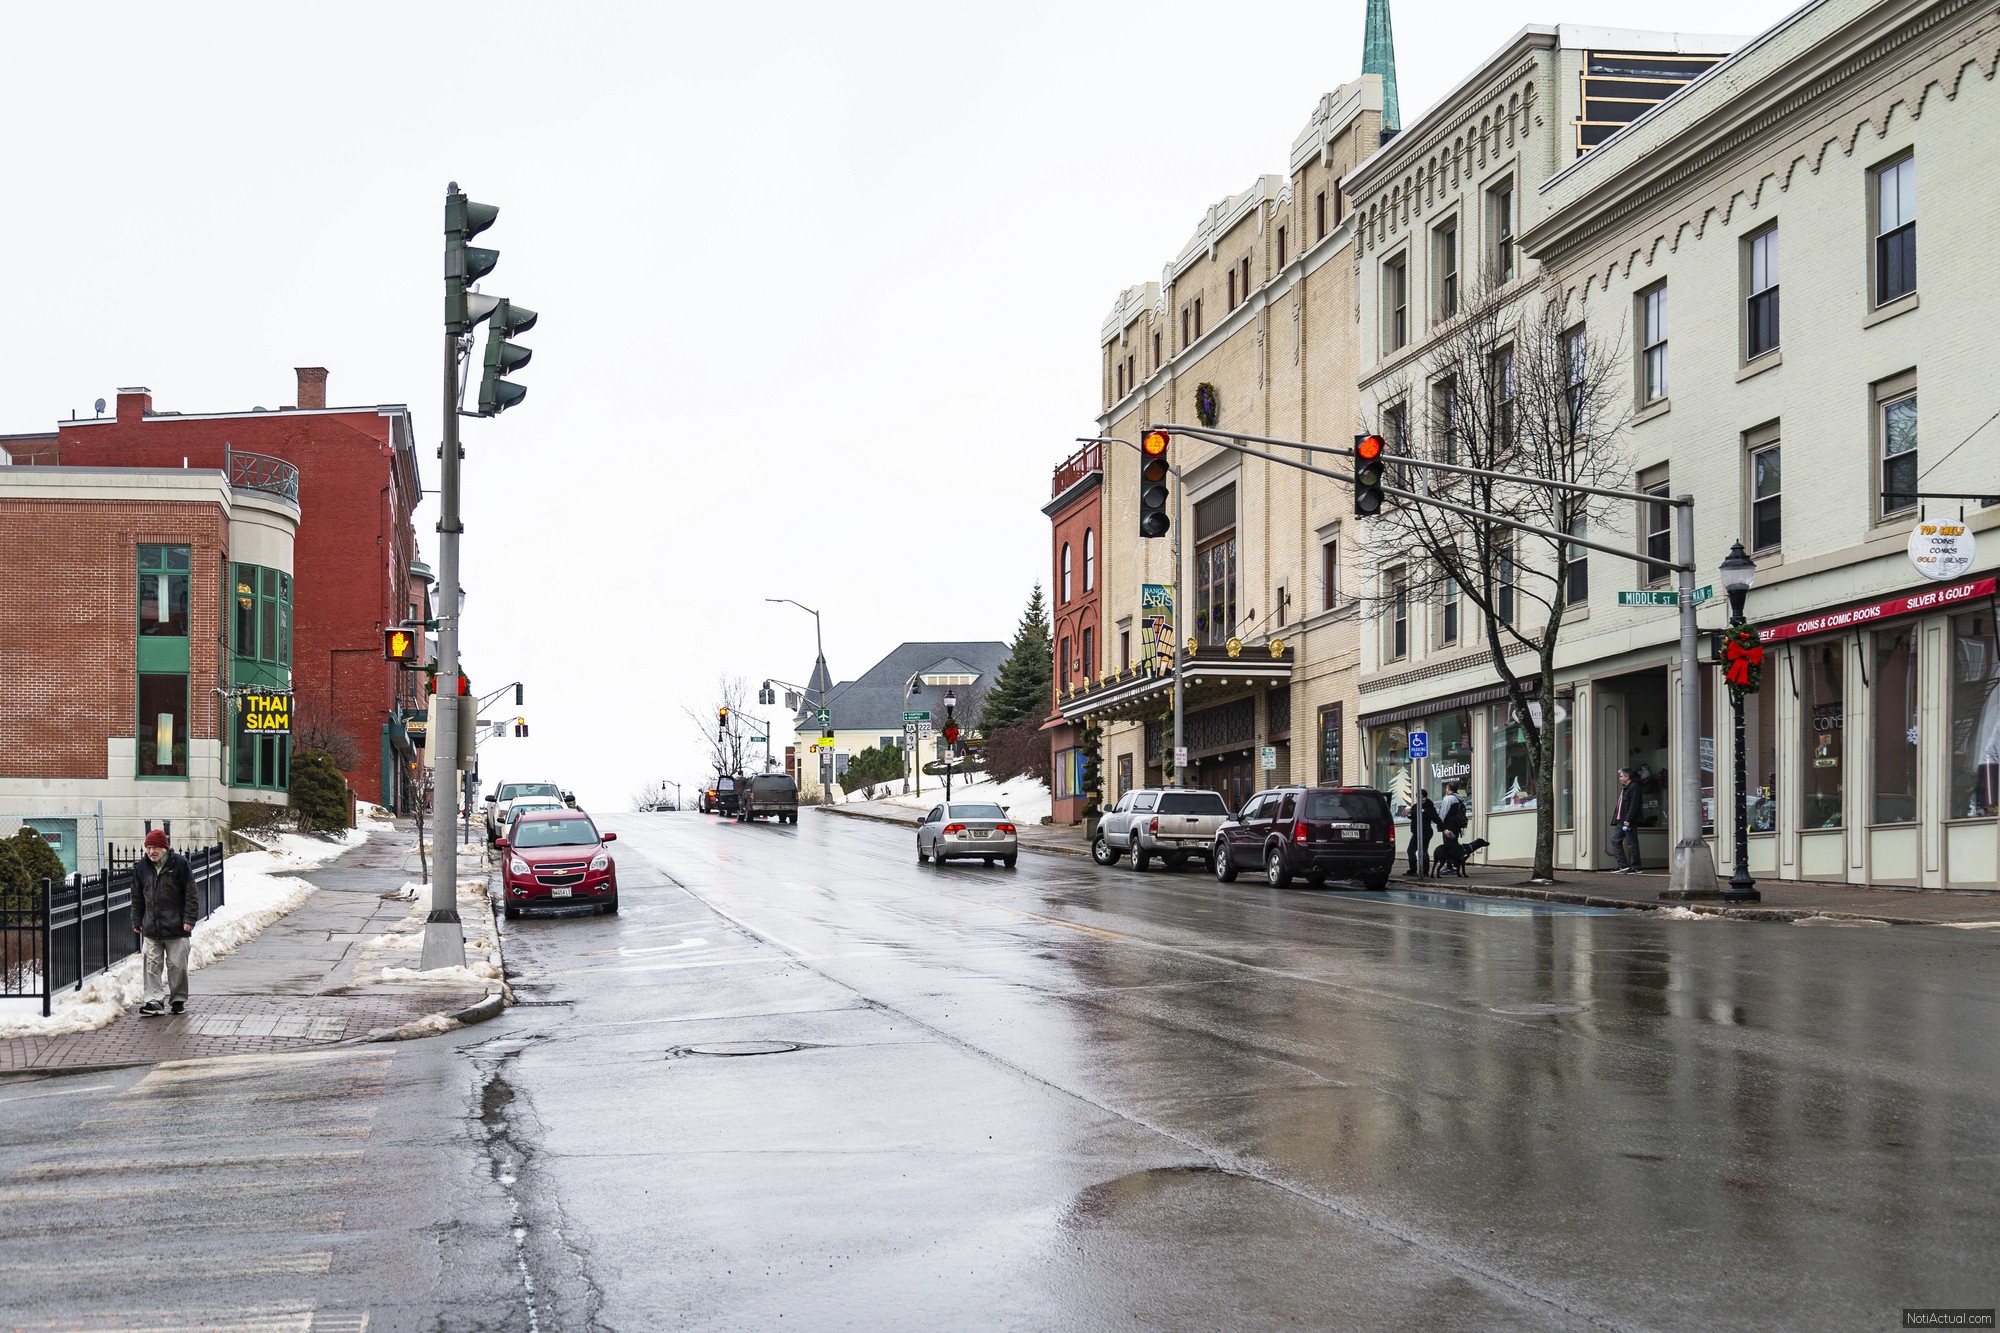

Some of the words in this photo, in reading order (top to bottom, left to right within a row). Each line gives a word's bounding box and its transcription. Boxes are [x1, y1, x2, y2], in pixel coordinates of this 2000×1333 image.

[1920, 525, 1937, 535] TOP
[1939, 526, 1965, 536] SHELF
[1142, 591, 1173, 607] ARTS
[1625, 592, 1658, 605] MIDDLE
[1662, 596, 1671, 605] ST
[1692, 588, 1706, 603] MAIN
[1796, 619, 1820, 633] COINS
[1820, 618, 1826, 628] &
[1827, 612, 1852, 626] COMIC
[1852, 605, 1881, 621] BOOKS
[1906, 593, 1936, 609] SILVER
[1938, 591, 1944, 602] &
[246, 695, 288, 712] THAI
[246, 712, 289, 729] SIAM
[919, 723, 931, 731] 222
[1431, 762, 1470, 778] Valentine
